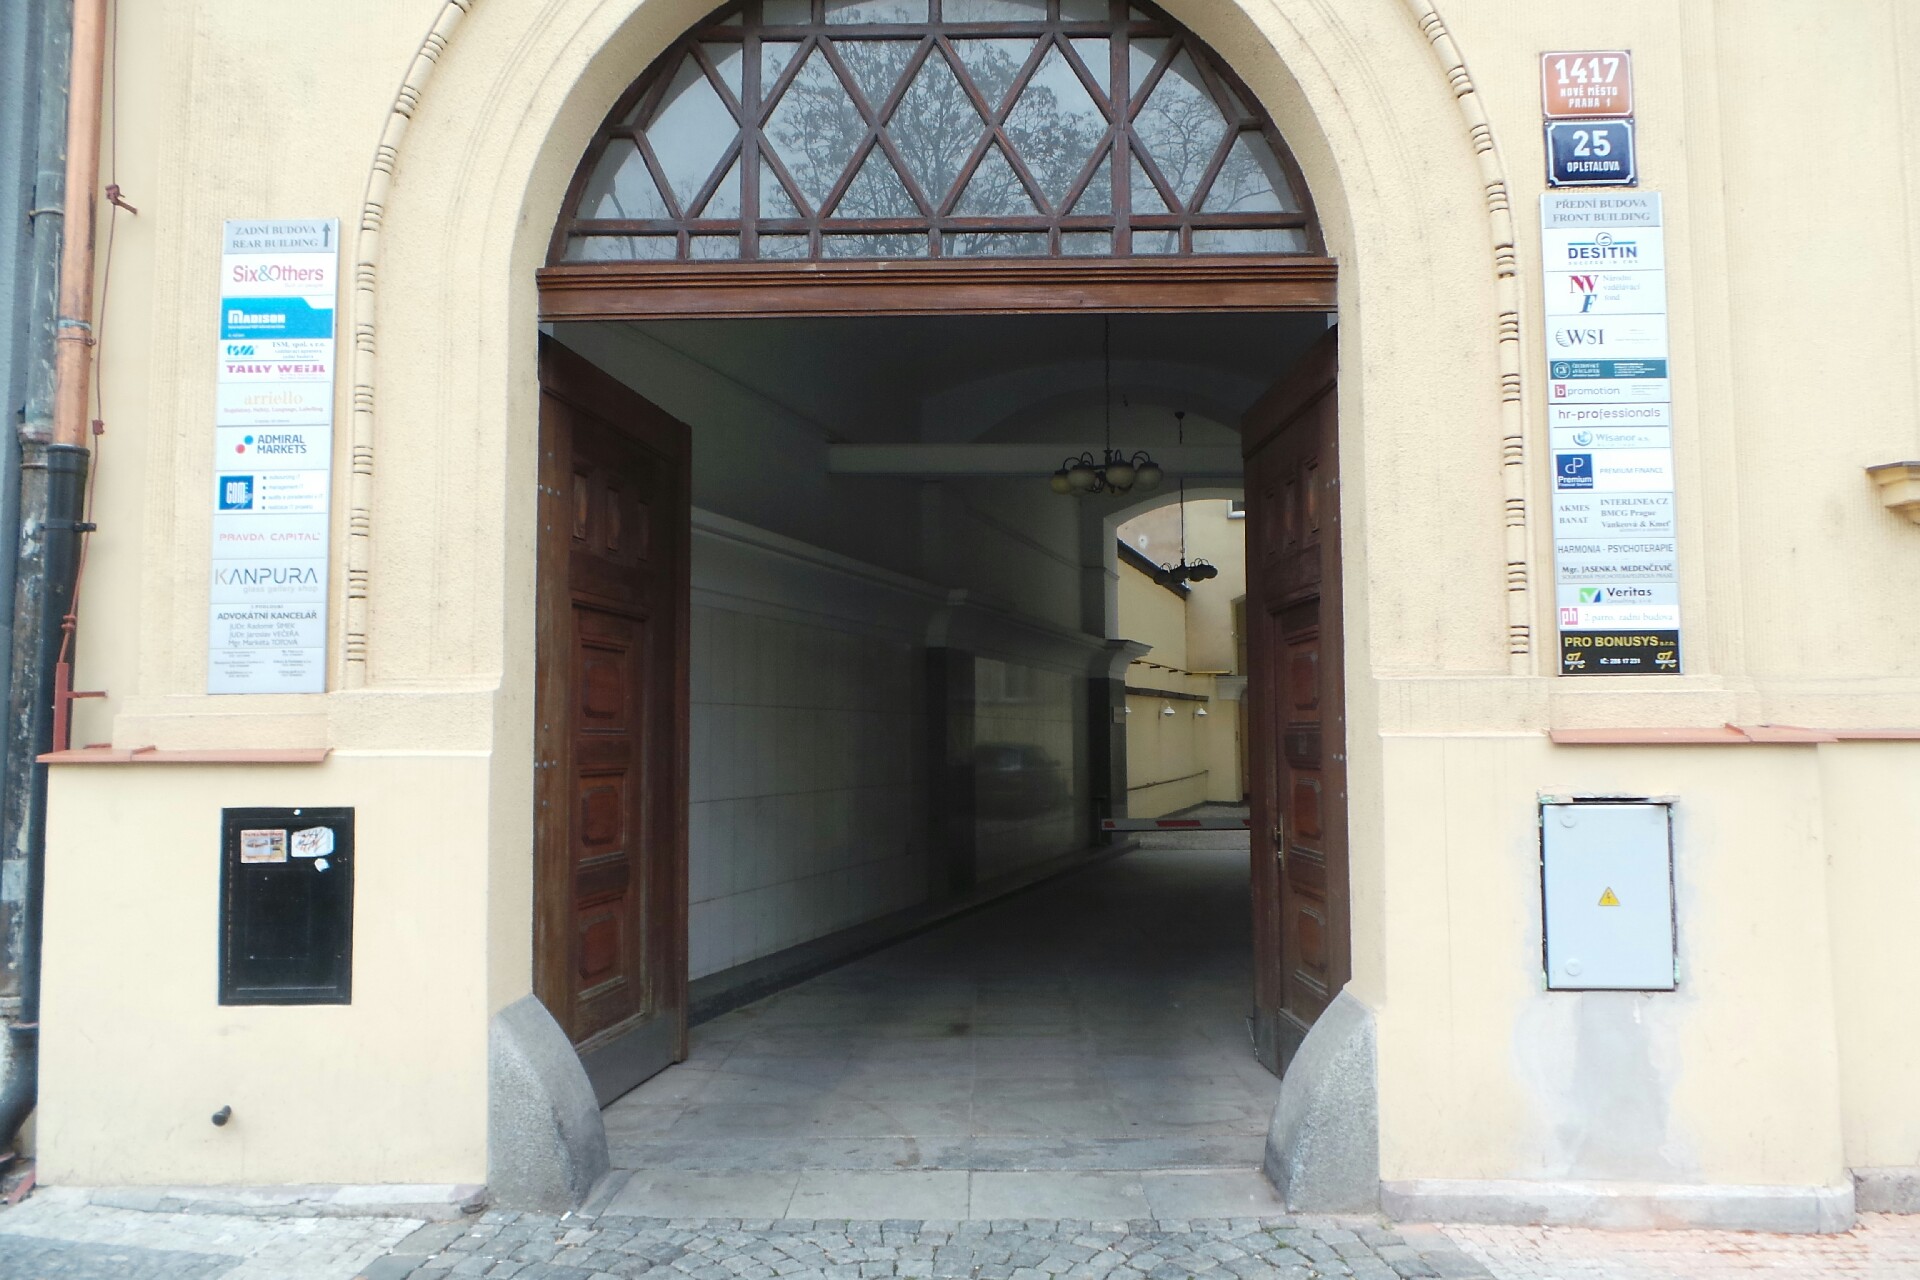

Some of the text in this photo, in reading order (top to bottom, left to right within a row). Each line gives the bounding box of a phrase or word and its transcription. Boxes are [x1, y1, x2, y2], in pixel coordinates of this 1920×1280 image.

[1555, 57, 1619, 84] 1417
[1560, 84, 1618, 97] NOVÉ MĚSTO
[1568, 98, 1611, 108] PRAHA 1
[1572, 130, 1611, 157] 25
[1566, 161, 1620, 172] OPLETALOVA
[1555, 199, 1647, 209] PŘEDNÍ BUDOVA
[1553, 212, 1650, 222] FRONT BUILDING
[235, 225, 317, 235] ZADNÍ BUDOVA
[232, 238, 318, 248] REAR BUILDING
[1567, 246, 1638, 259] DESITIN
[232, 264, 324, 283] Six&Others
[1566, 329, 1604, 345] WSI
[226, 364, 272, 374] TALLY
[1567, 386, 1620, 396] promotion
[243, 391, 304, 405] arriello
[1558, 408, 1661, 420] hr-professionals
[258, 434, 305, 444] ADMIRAL
[257, 444, 307, 454] MARKETS
[1558, 475, 1592, 483] Premium
[1559, 504, 1590, 512] AKMES
[1600, 509, 1628, 517] BMCG
[270, 532, 320, 541] CAPITAL
[1557, 545, 1601, 554] HARMONIA
[1607, 543, 1673, 553] PSYCHOTERAPIE
[1581, 565, 1617, 574] JASENKA
[215, 567, 318, 585] KANPURA
[243, 584, 319, 594] glass gallery shop
[1606, 586, 1652, 597] Veritas
[1564, 636, 1592, 647] PRO
[1594, 636, 1659, 647] BONUSYS
